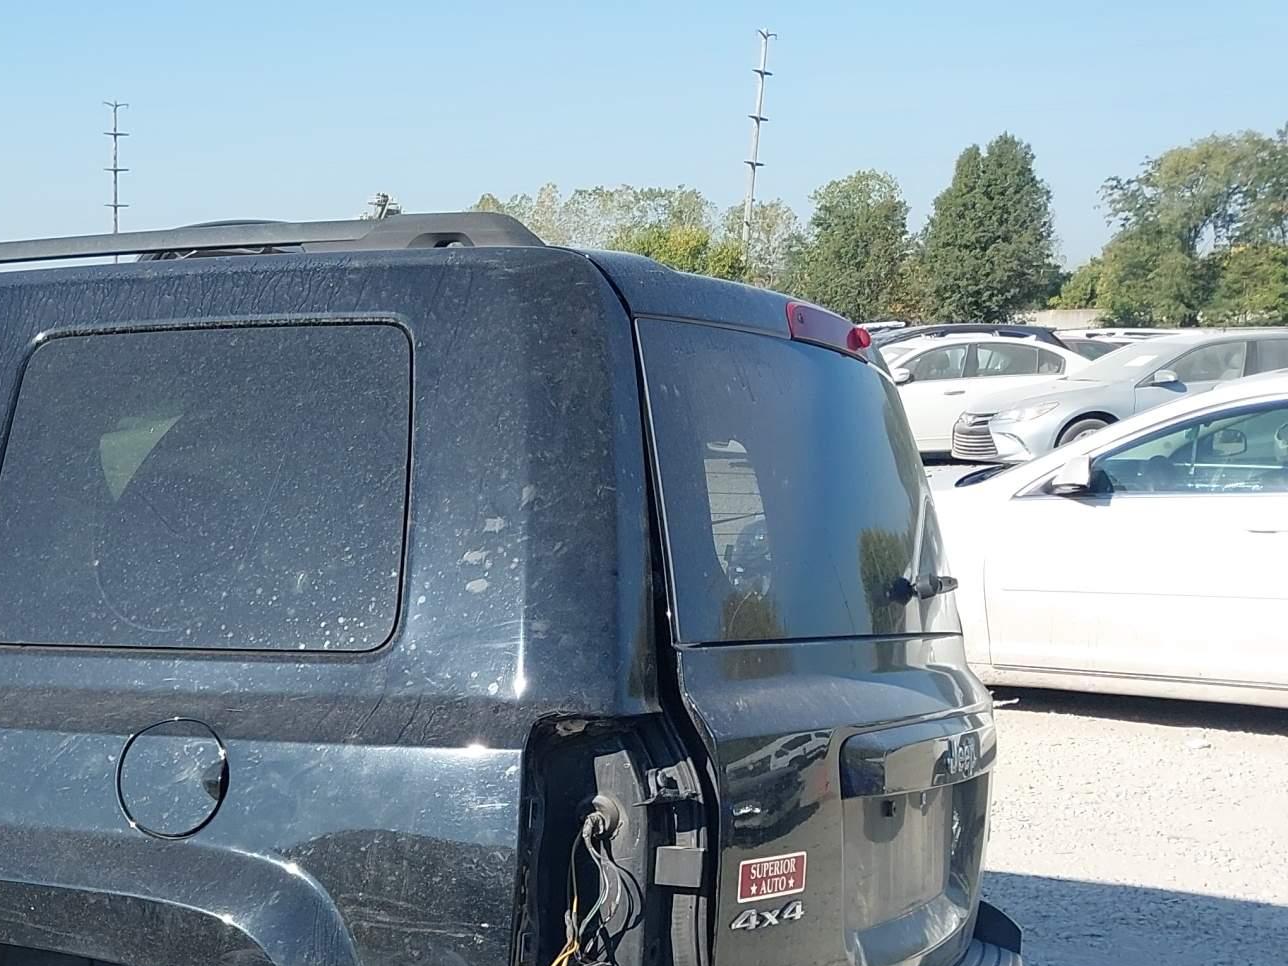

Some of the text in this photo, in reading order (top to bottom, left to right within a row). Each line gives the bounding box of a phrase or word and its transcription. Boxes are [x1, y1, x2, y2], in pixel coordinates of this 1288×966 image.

[947, 736, 977, 778] Jeep
[750, 858, 796, 880] SUPERIOR
[759, 876, 787, 894] AUTO
[730, 900, 805, 930] 4x4
